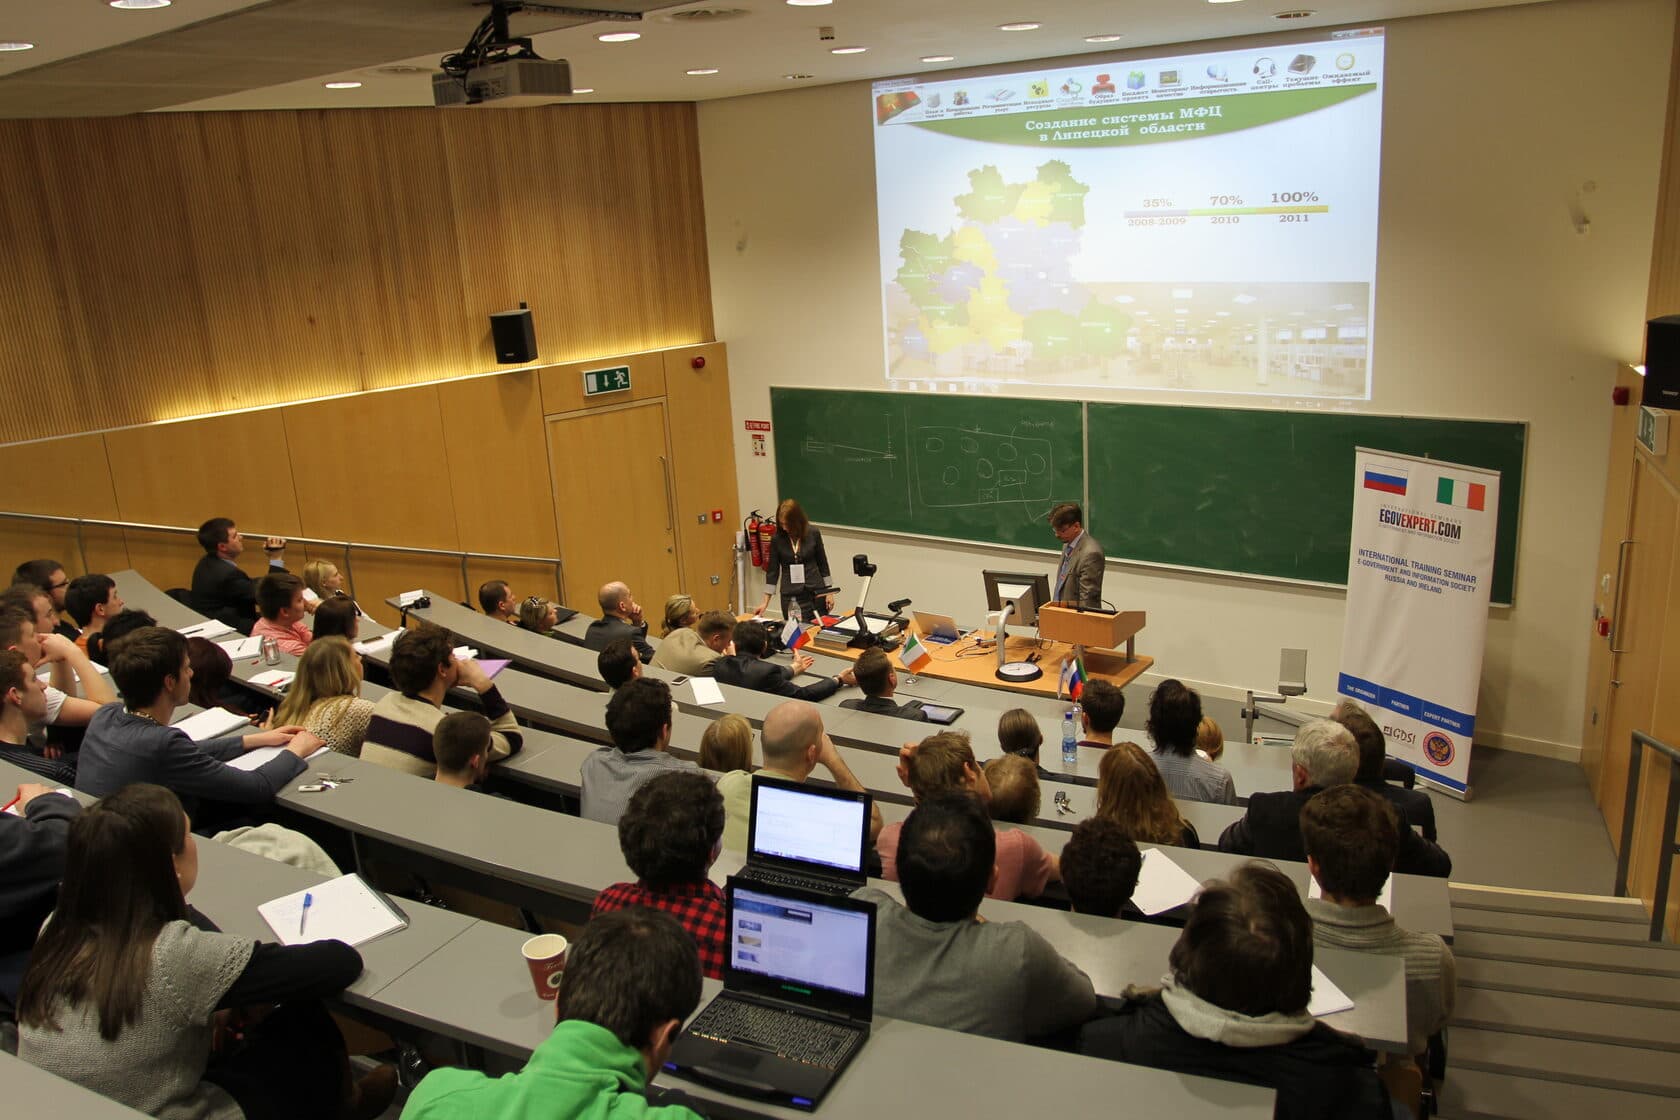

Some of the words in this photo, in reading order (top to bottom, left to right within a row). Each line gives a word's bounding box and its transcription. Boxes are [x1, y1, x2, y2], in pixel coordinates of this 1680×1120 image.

[1025, 116, 1097, 130] Создание
[1102, 112, 1174, 126] системы
[1180, 106, 1224, 120] МФЦ
[1039, 132, 1048, 142] в
[1053, 126, 1130, 141] Липецкой
[1140, 122, 1206, 135] области
[1143, 198, 1172, 208] 35%
[1210, 194, 1244, 206] 70%
[1271, 191, 1319, 204] 100%
[1128, 217, 1186, 227] 2008-2009
[1210, 216, 1240, 224] 2010
[1279, 214, 1310, 223] 2011
[1380, 508, 1462, 540] EGOVEXPERT.COM
[1358, 548, 1408, 568] INTERNATIONAL
[1410, 560, 1442, 576] TRAINING
[1442, 569, 1477, 584] SEMINAR
[1358, 558, 1398, 574] E-GOVERNMENT
[1400, 568, 1412, 576] AND
[1412, 572, 1450, 587] INFORMATION
[1450, 581, 1476, 593] SOCIETY
[1384, 574, 1406, 584] RUSSIA
[1418, 582, 1442, 594] IRELAND
